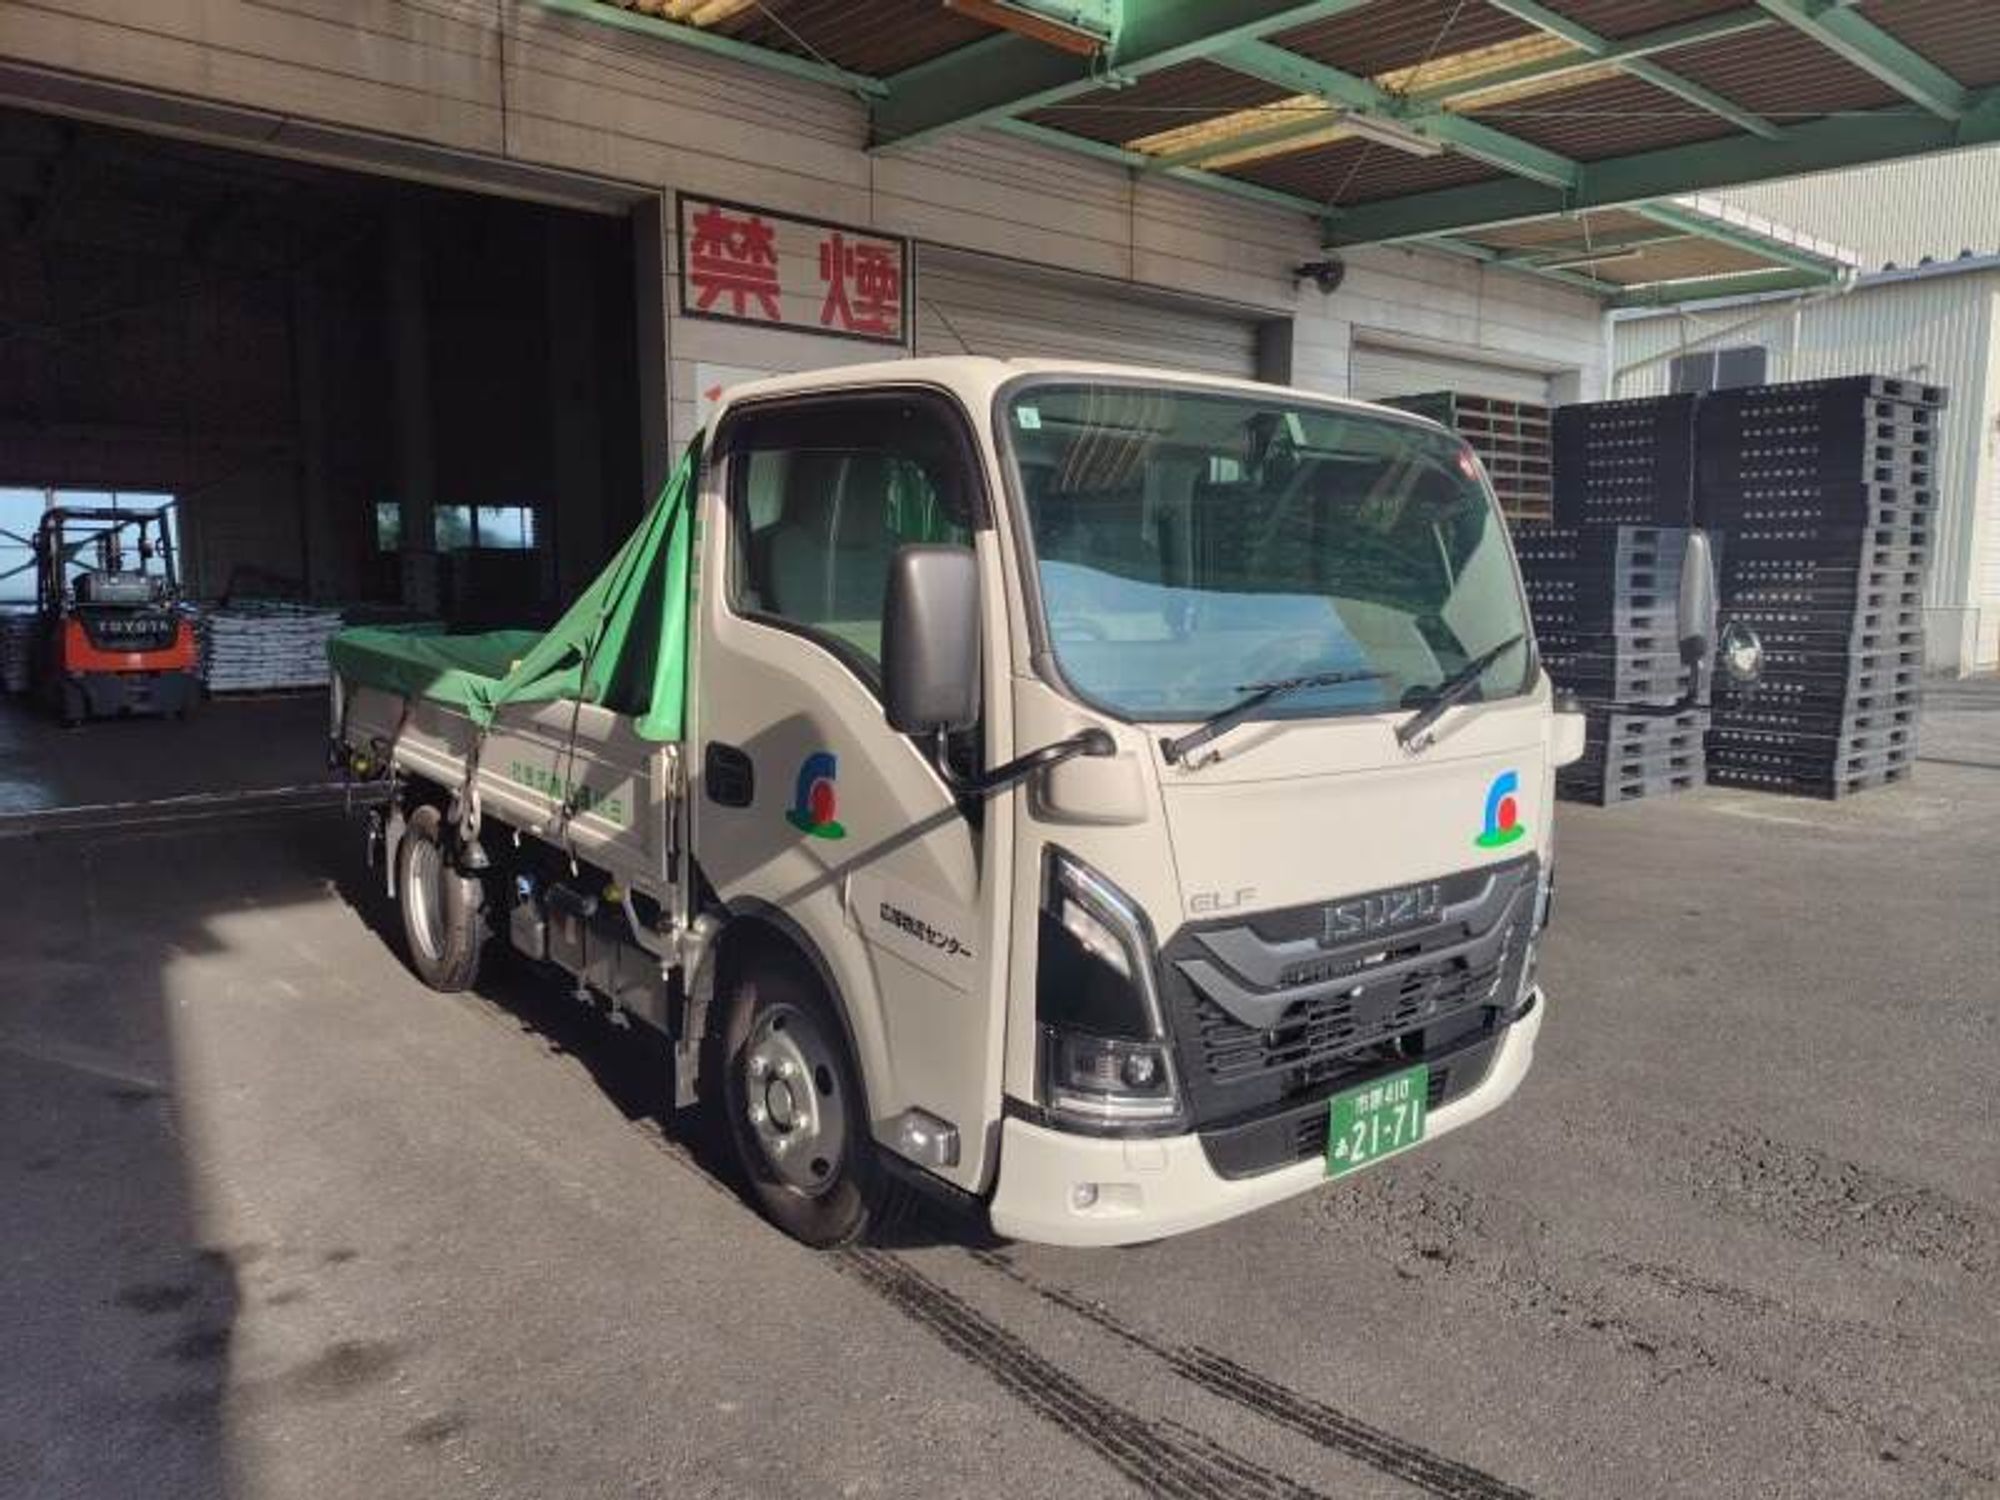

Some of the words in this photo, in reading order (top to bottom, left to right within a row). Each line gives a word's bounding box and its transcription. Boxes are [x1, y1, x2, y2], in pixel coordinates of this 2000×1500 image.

[691, 205, 899, 333] 禁煙
[1190, 888, 1256, 913] ELF
[1324, 883, 1440, 941] ISUZU
[1385, 1079, 1409, 1101] 410
